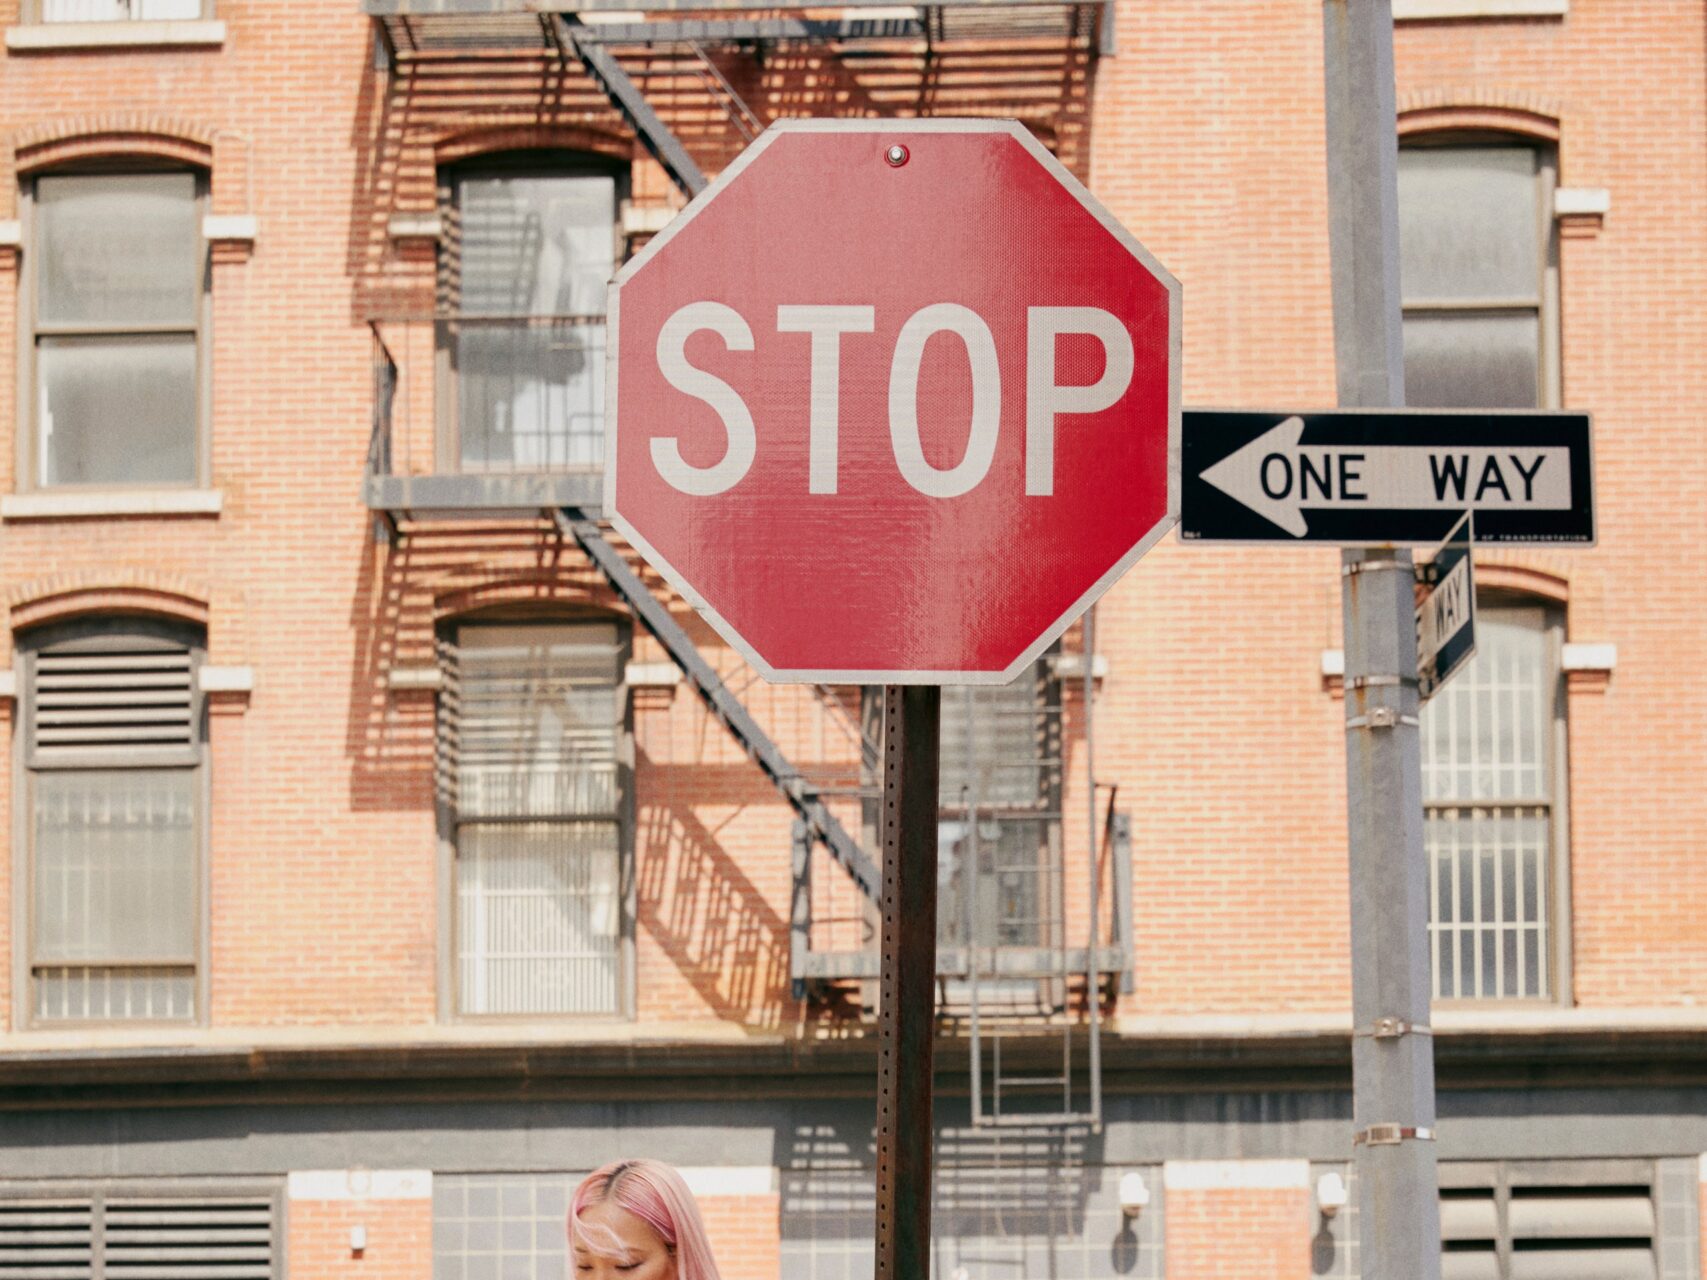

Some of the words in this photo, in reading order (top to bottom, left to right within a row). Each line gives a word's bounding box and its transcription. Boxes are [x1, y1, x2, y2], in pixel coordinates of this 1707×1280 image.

[649, 301, 1135, 498] STOP
[1260, 452, 1368, 501] ONE
[1429, 454, 1546, 502] WAY
[1499, 533, 1588, 541] TRANSPORTATION
[1434, 568, 1464, 642] WAY
